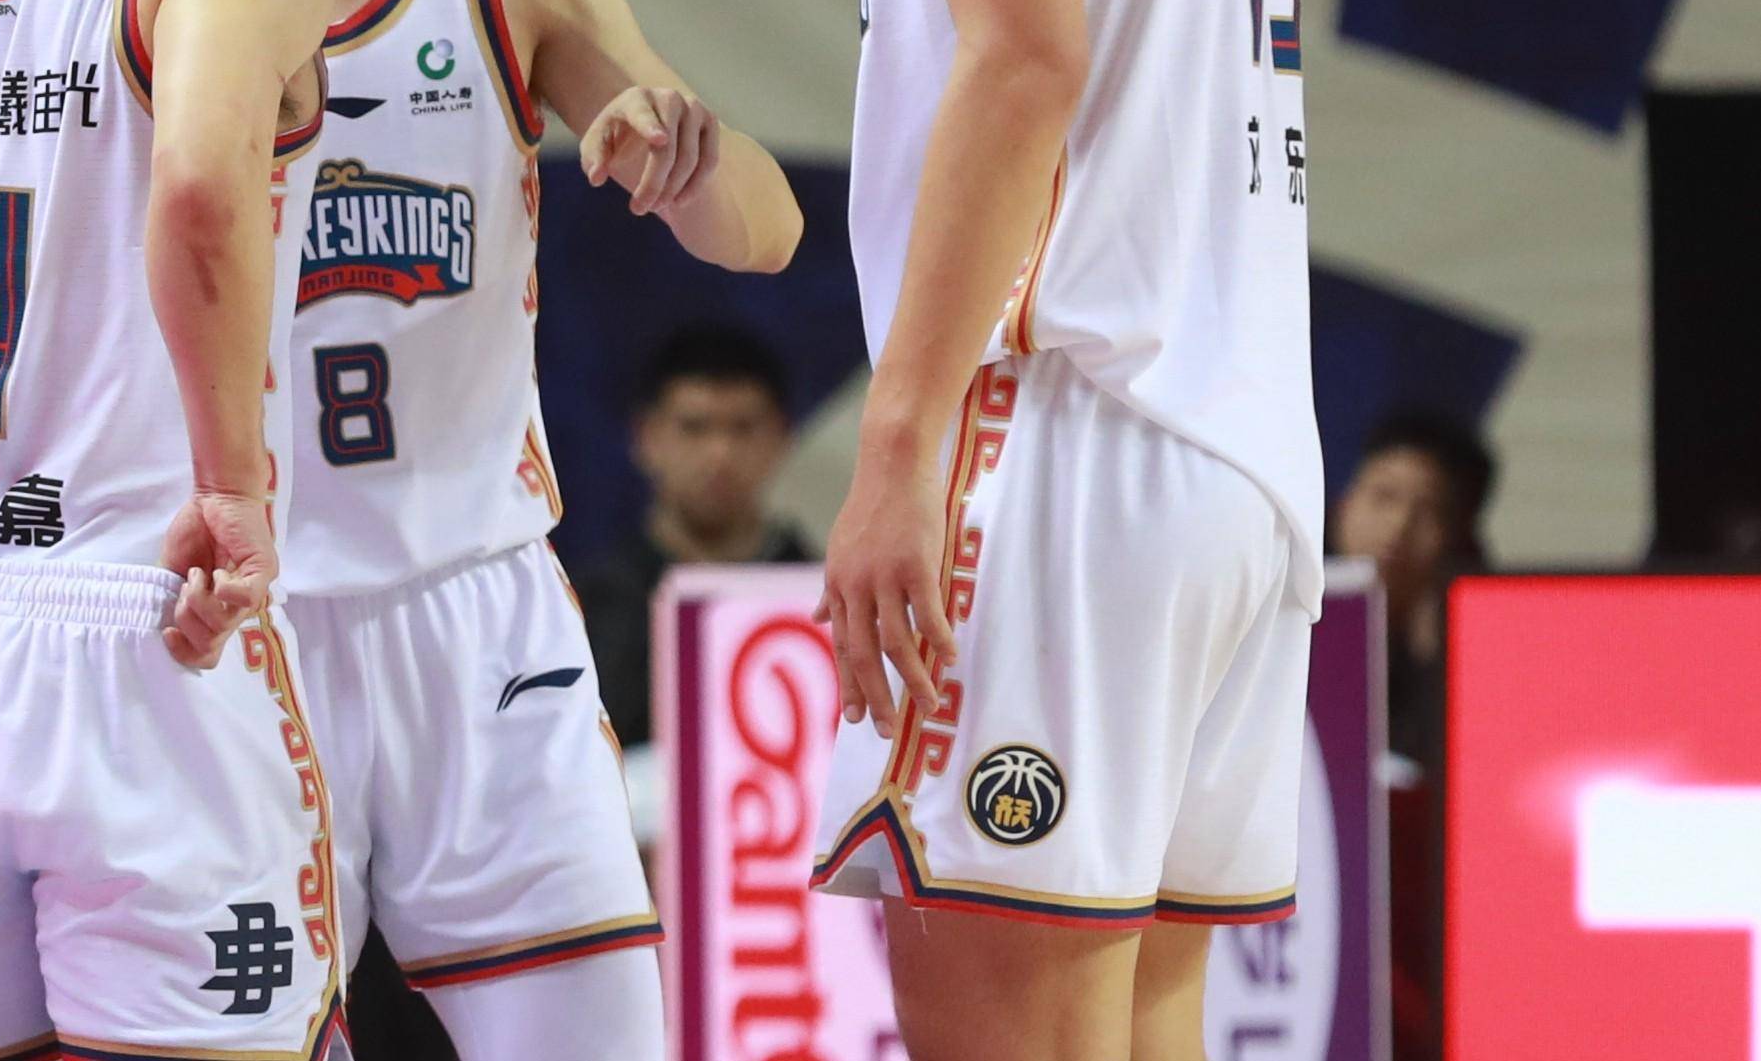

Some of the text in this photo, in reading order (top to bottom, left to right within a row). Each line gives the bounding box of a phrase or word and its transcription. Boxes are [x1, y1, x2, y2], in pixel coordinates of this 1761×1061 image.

[411, 101, 472, 115] CHINA LIFE
[312, 342, 397, 467] 8
[730, 610, 842, 1061] Cant
